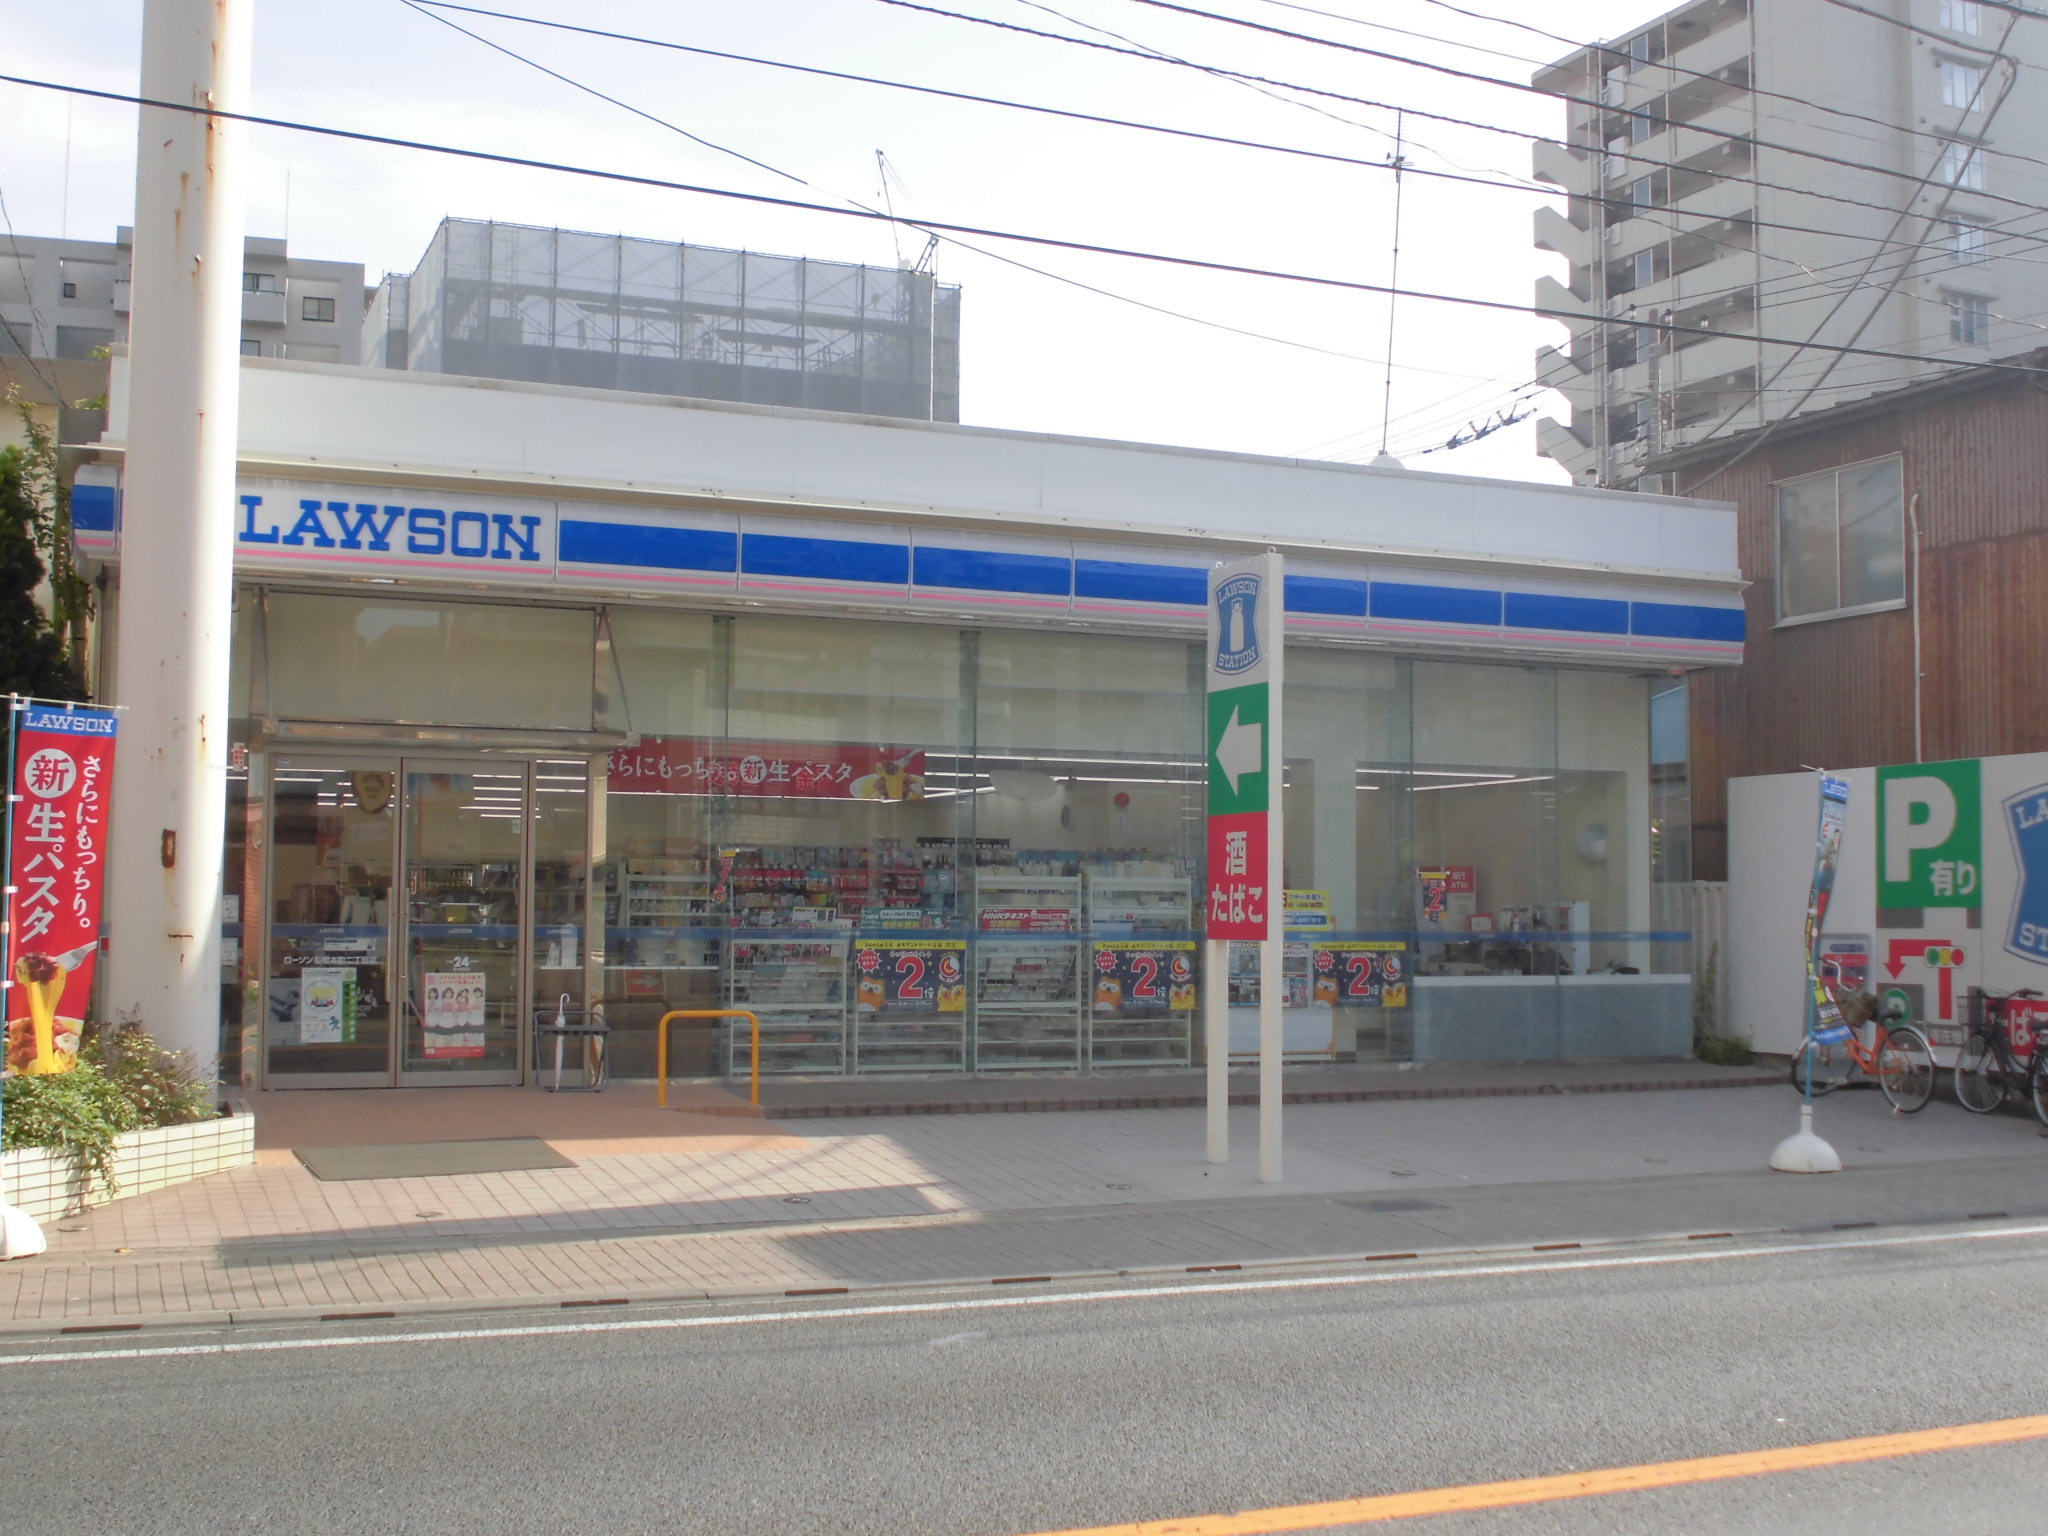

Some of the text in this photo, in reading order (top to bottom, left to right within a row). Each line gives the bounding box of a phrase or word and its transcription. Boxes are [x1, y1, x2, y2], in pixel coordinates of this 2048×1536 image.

[239, 495, 541, 561] LAWSON
[1217, 580, 1257, 604] LAWSON
[1218, 646, 1256, 667] STATION
[24, 711, 114, 734] LAWSON
[71, 754, 102, 930] さらにもっちり。
[1884, 776, 1957, 882] P
[1225, 831, 1247, 876] 酒
[1929, 860, 1976, 897] 有り
[1211, 882, 1264, 925] たばこ
[453, 956, 470, 967] 24
